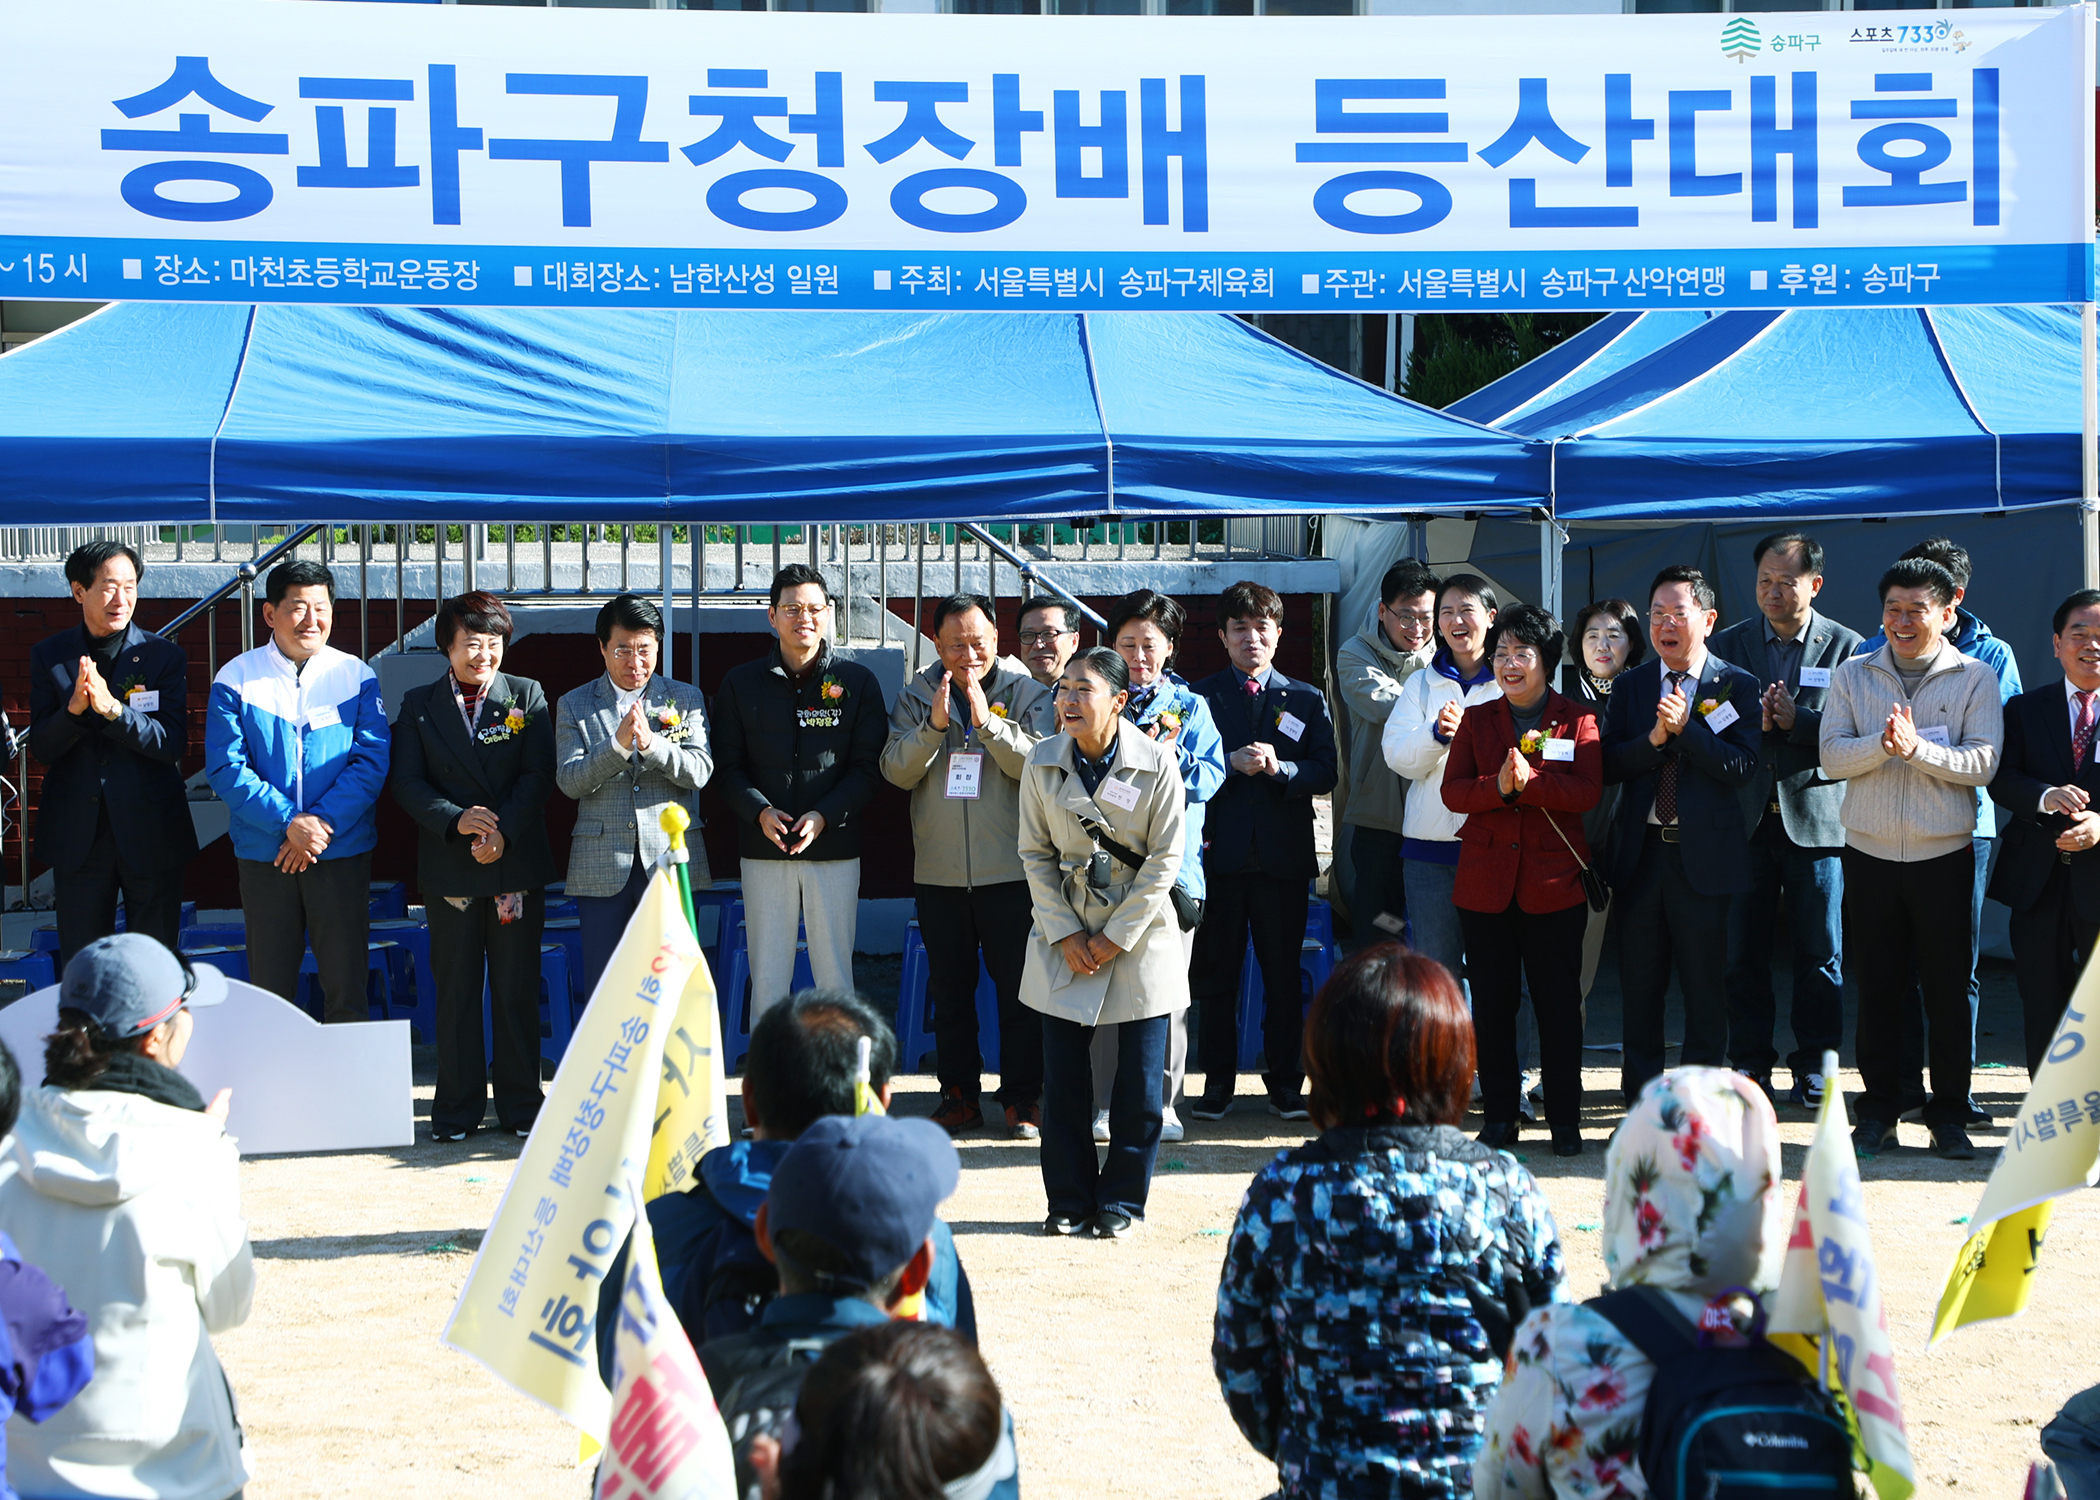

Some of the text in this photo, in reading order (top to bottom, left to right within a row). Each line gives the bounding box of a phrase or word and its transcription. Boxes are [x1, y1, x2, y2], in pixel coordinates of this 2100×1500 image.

[1769, 33, 1822, 53] 송파구
[1848, 26, 1895, 43] 스포츠
[100, 55, 2000, 235] 송파구청장배 등산대회
[154, 254, 481, 291] 장소: 마천초등학교운동장
[543, 261, 839, 295] 대회장소: 남한산성 일원
[899, 265, 1274, 298] 주최: 서울특별시 송파구체육회
[1324, 269, 1386, 299] 주관:
[1397, 268, 1526, 299] 서울특별시
[1778, 263, 1941, 296] 후원: 송파구
[1757, 1433, 1810, 1450] Columbia
